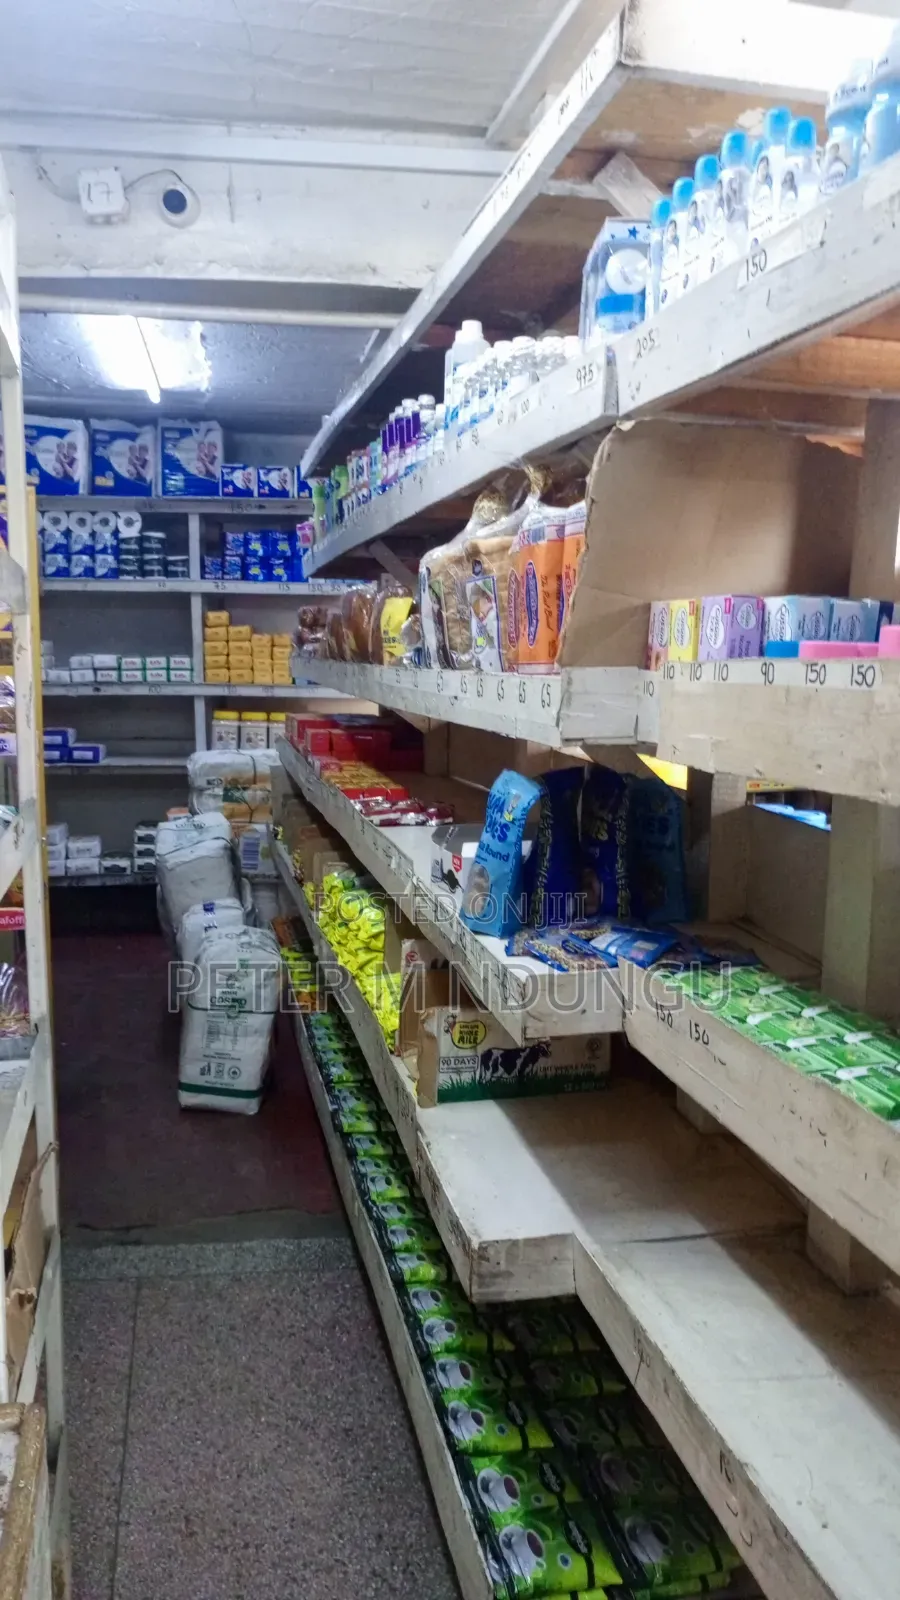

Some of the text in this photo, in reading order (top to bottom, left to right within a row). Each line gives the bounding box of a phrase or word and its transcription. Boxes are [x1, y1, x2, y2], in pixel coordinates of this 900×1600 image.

[745, 248, 767, 282] 150
[636, 333, 656, 358] 205
[662, 663, 675, 680] 110
[689, 663, 703, 682] 110
[713, 663, 729, 682] 110
[760, 661, 775, 686] 90
[804, 663, 827, 686] 150
[850, 662, 876, 688] 150
[643, 680, 655, 697] 110
[655, 999, 710, 1045] 150 150
[457, 1036, 478, 1045] MILK
[440, 1057, 477, 1066] 90 DAYS
